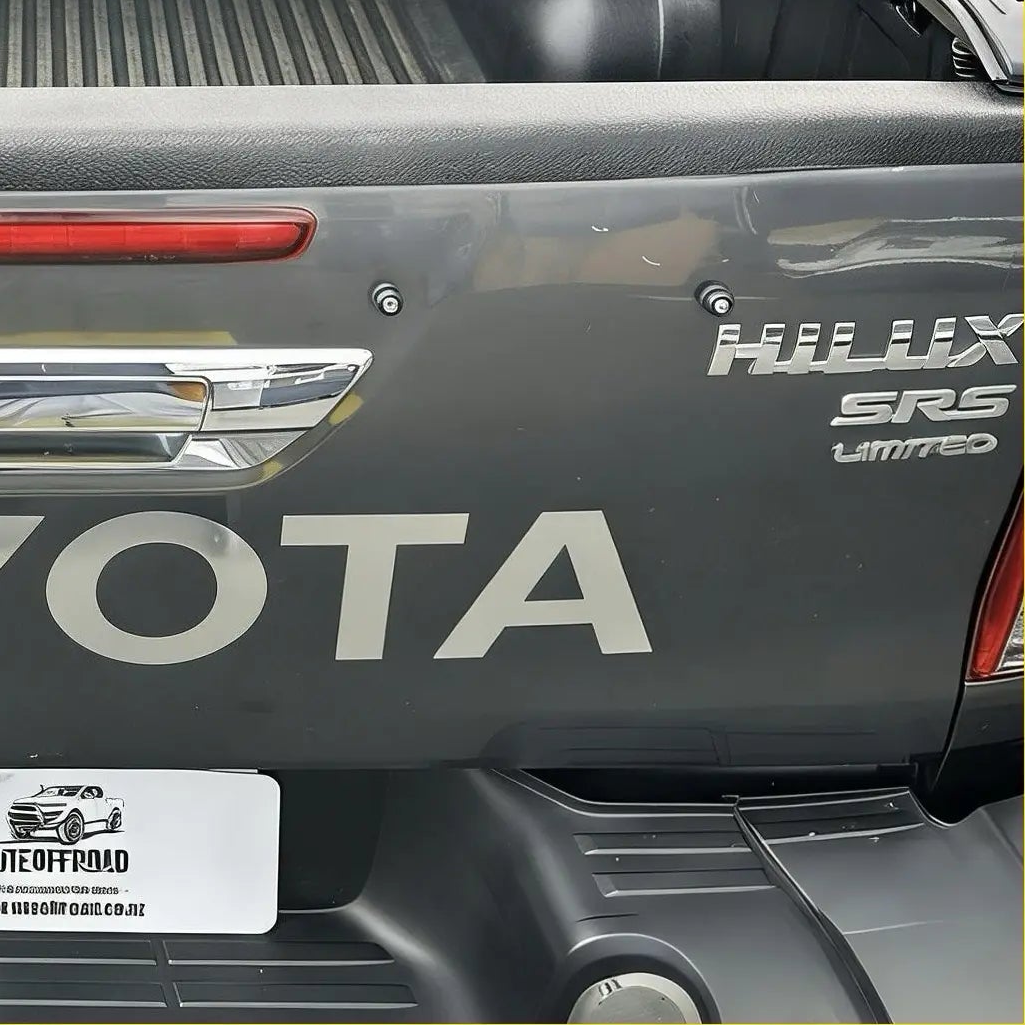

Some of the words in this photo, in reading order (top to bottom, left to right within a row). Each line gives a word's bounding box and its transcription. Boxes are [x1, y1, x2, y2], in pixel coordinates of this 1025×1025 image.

[708, 313, 1024, 376] HILUX
[830, 385, 1017, 426] SRS
[831, 433, 998, 463] LIMITED
